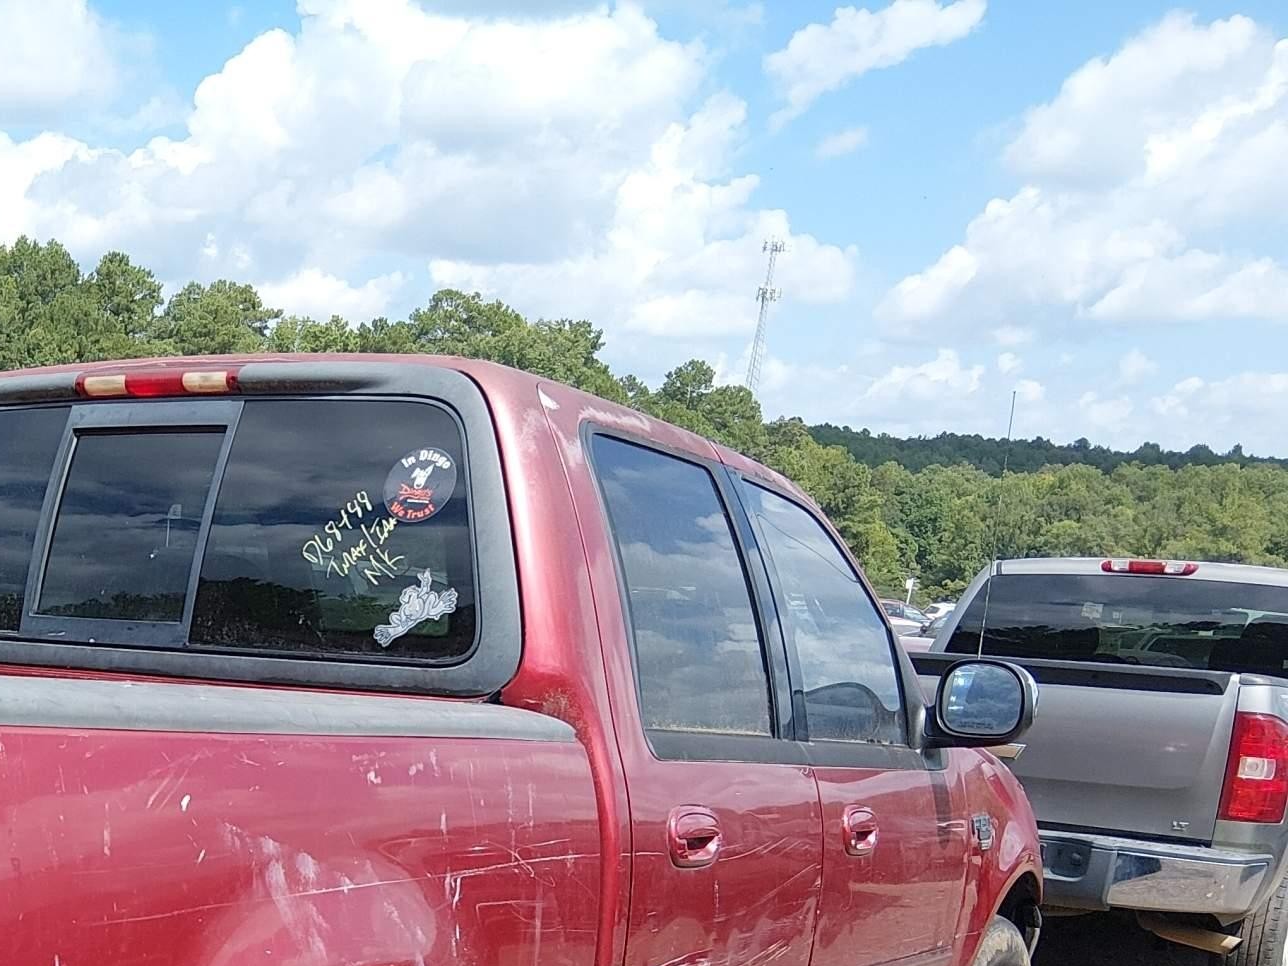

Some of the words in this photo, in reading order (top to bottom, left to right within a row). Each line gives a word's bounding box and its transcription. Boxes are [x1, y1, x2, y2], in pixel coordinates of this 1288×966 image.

[401, 456, 416, 468] In
[419, 450, 451, 469] Dingo
[391, 502, 405, 517] We
[406, 503, 435, 519] Trust
